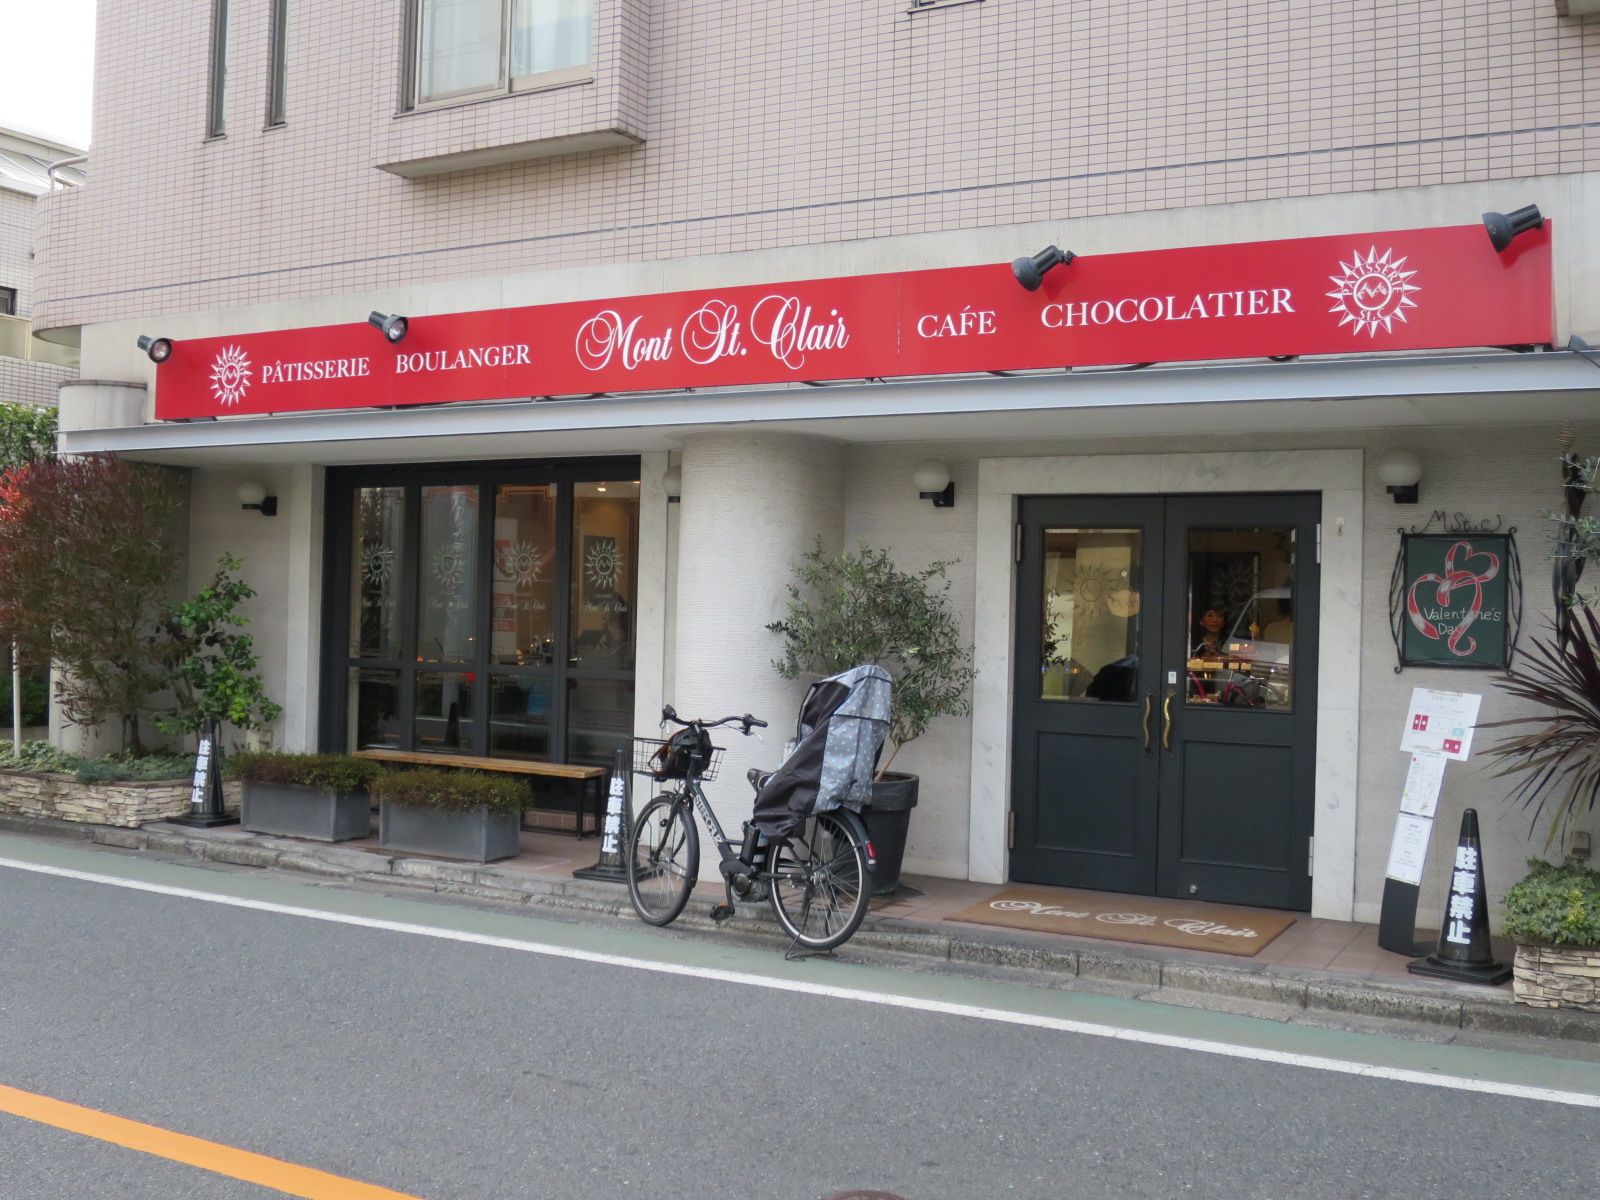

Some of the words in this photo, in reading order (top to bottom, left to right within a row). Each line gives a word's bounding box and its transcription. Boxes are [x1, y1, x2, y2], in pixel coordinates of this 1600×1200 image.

[1040, 287, 1296, 329] CHOCOLATIER
[575, 309, 673, 371] Mont
[681, 298, 748, 365] St.
[750, 294, 850, 370] Clair
[261, 357, 370, 384] PÂTISSERIE
[395, 344, 532, 374] BOULANGER
[1424, 607, 1502, 622] Valentne's
[1447, 846, 1478, 945] 駐車禁止
[1163, 918, 1258, 938] Clair
